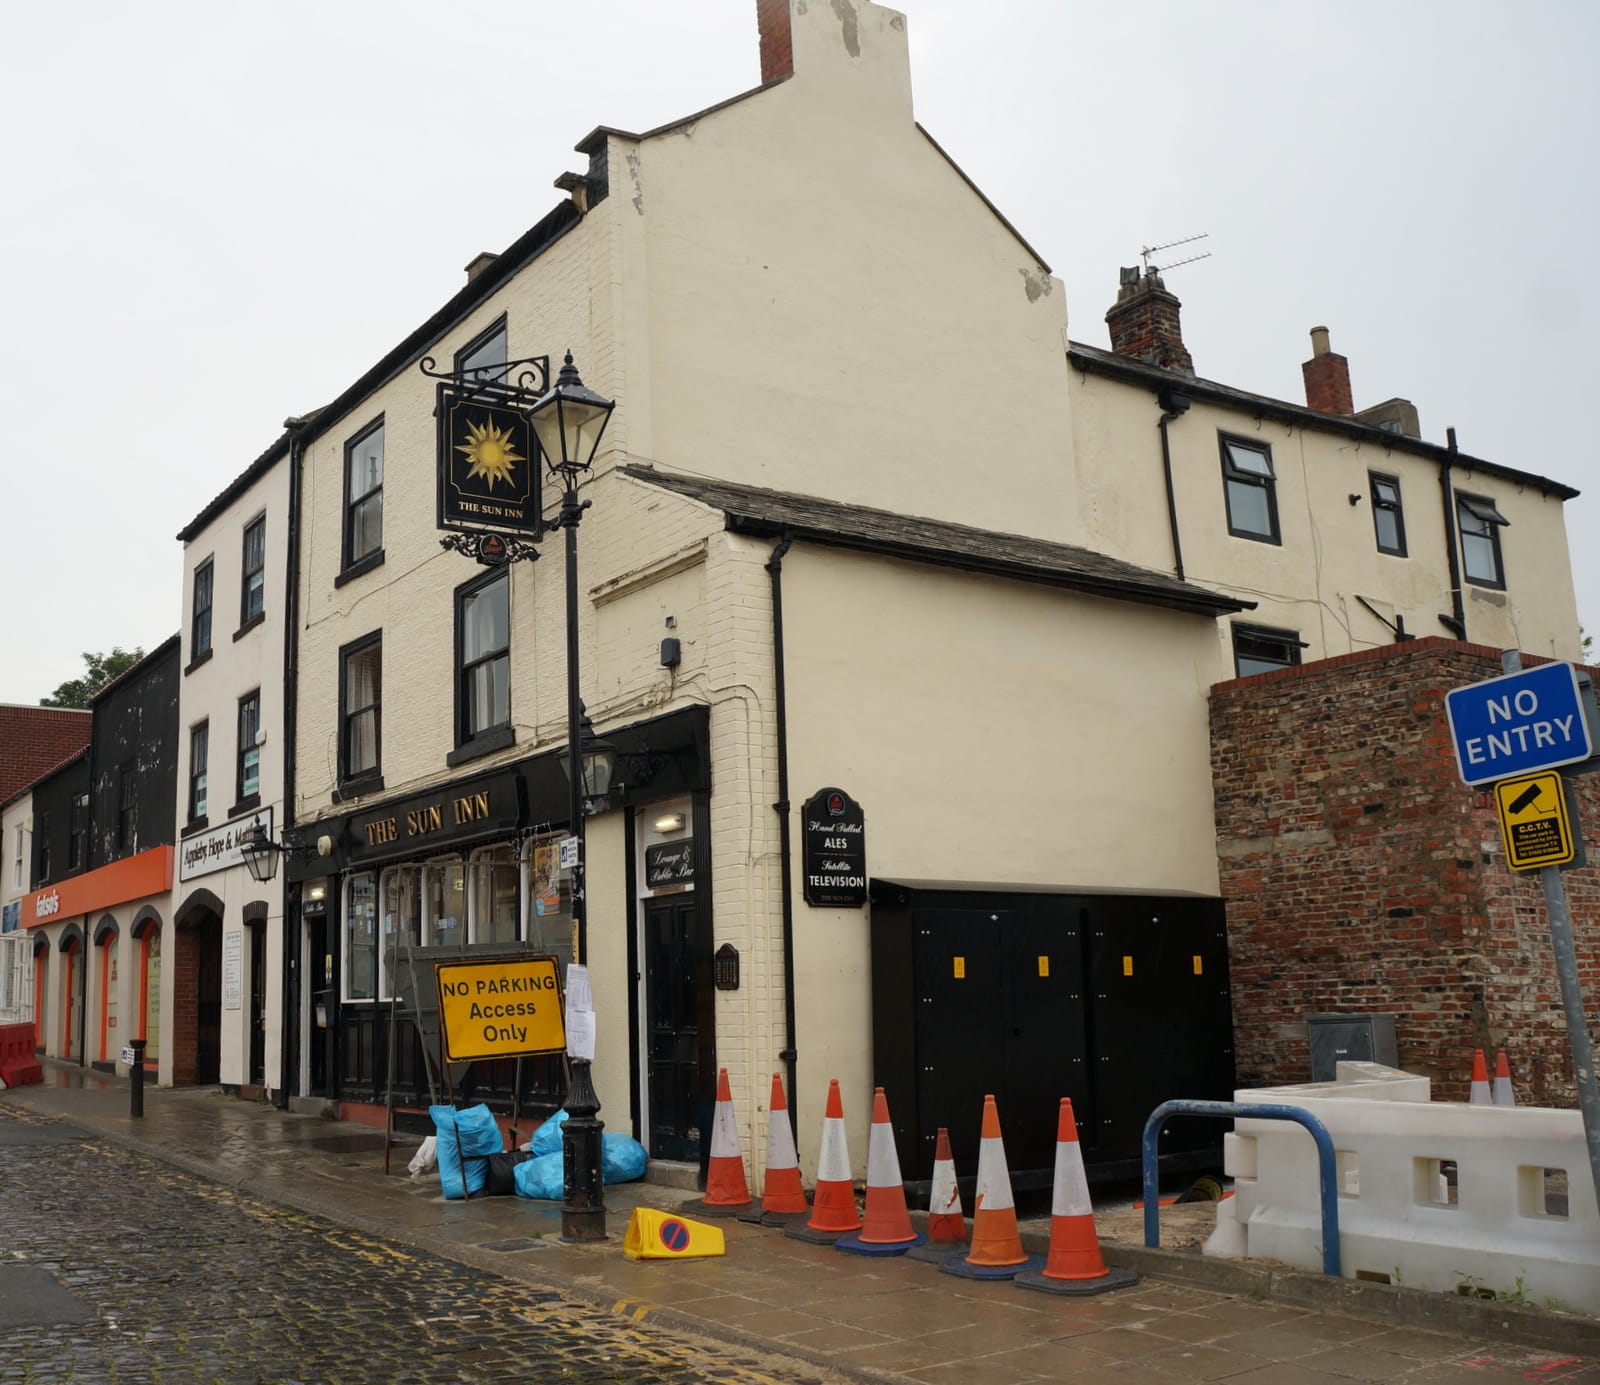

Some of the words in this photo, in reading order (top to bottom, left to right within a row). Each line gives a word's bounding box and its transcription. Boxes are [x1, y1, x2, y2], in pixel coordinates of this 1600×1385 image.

[458, 501, 480, 512] THE
[481, 505, 502, 516] SUN
[504, 508, 524, 519] INN
[1486, 689, 1539, 725] NO
[1465, 714, 1574, 765] ENTRY
[365, 817, 399, 847] THE
[407, 804, 443, 837] SUN
[453, 791, 490, 825] INN
[808, 821, 836, 833] Hand
[836, 822, 863, 834] Pulled
[1519, 821, 1551, 833] C.C.T.V.
[208, 837, 225, 860] Hope
[226, 831, 233, 851] &
[824, 838, 848, 849] ALES
[654, 850, 681, 866] Lounge
[682, 845, 691, 863] &
[821, 859, 852, 871] Satellite
[650, 866, 673, 882] Public
[675, 862, 695, 878] Bar
[809, 875, 864, 888] TELEVISION
[443, 982, 469, 997] NO
[476, 976, 556, 995] PARKING
[470, 1002, 536, 1020] Access
[483, 1023, 528, 1043] Only
